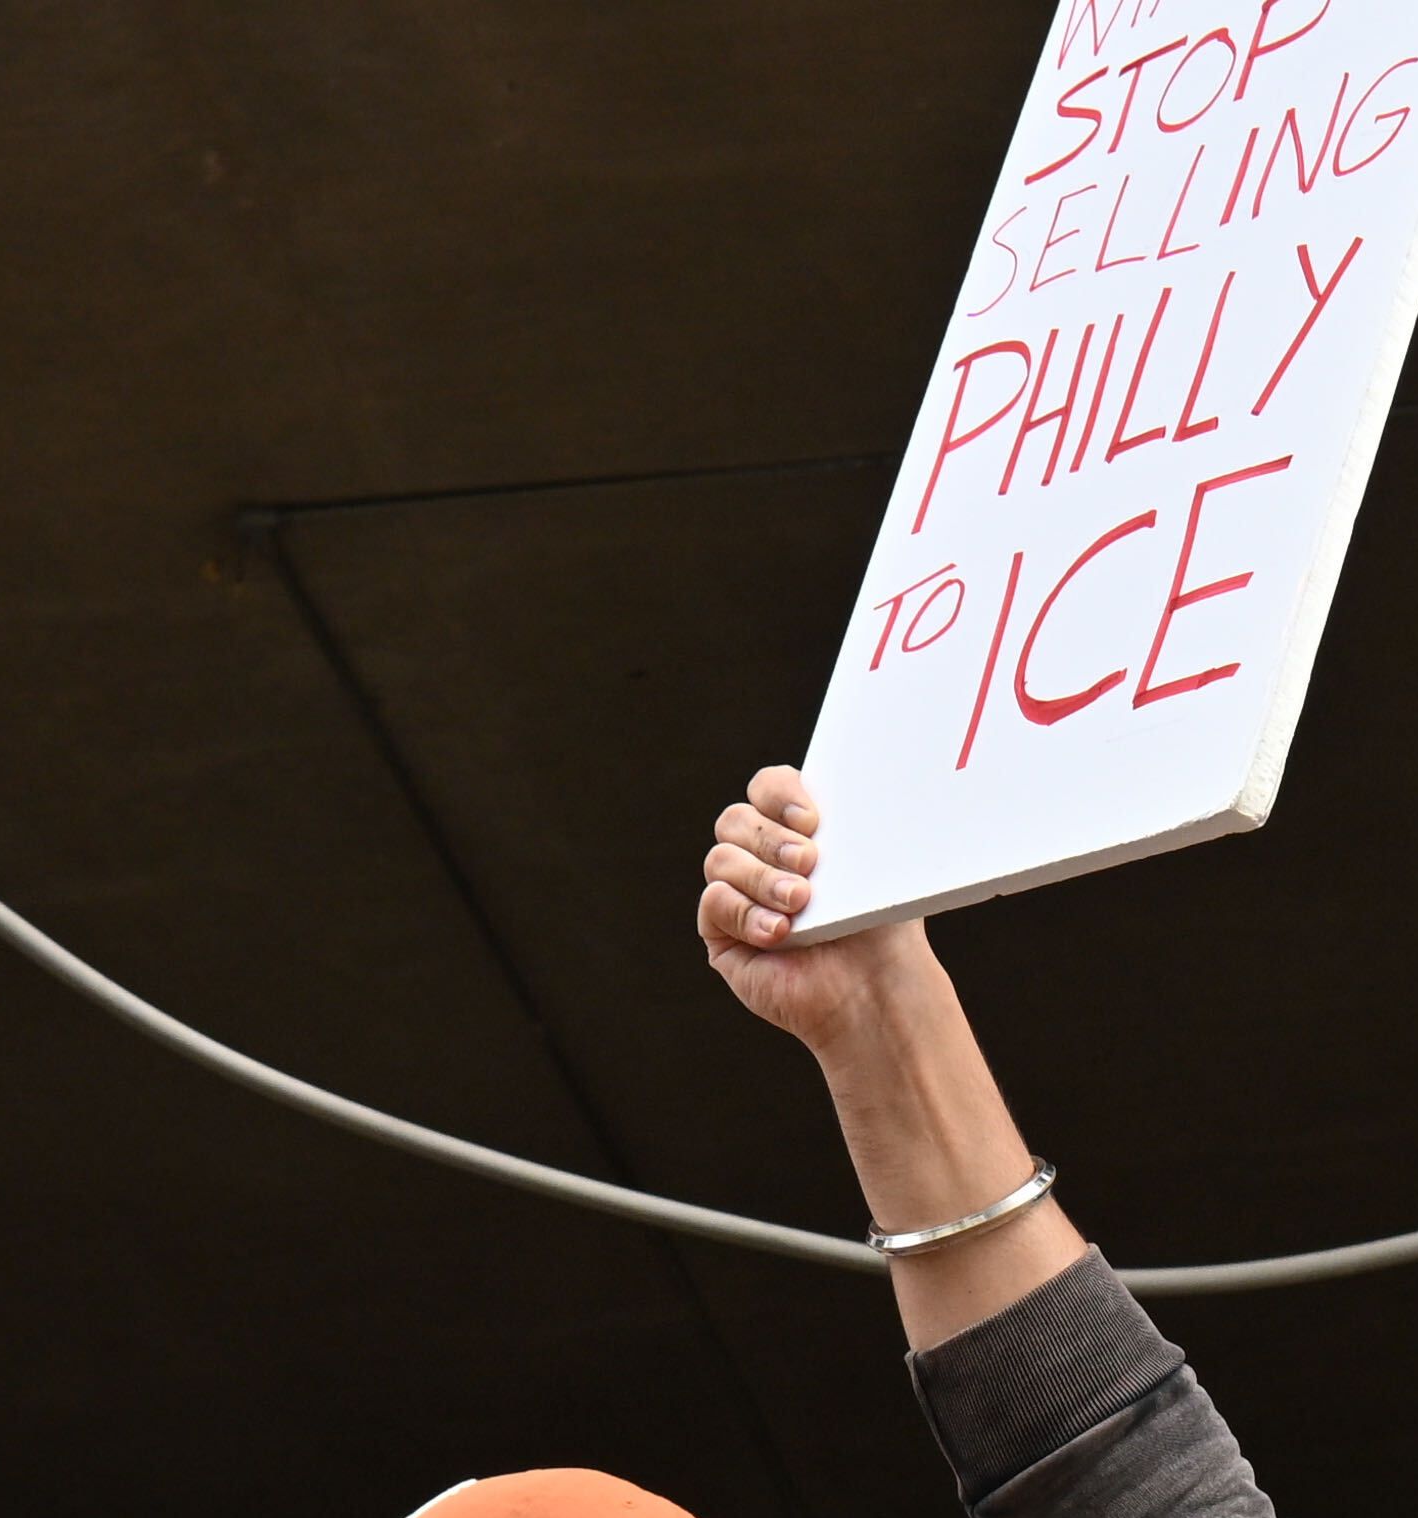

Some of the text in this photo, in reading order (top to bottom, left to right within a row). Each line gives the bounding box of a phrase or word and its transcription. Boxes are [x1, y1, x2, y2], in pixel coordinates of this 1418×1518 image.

[968, 57, 1418, 317] SELLING
[1025, 0, 1329, 184] STOP
[911, 237, 1363, 535] PHILLY
[869, 455, 1292, 771] TO ICE
